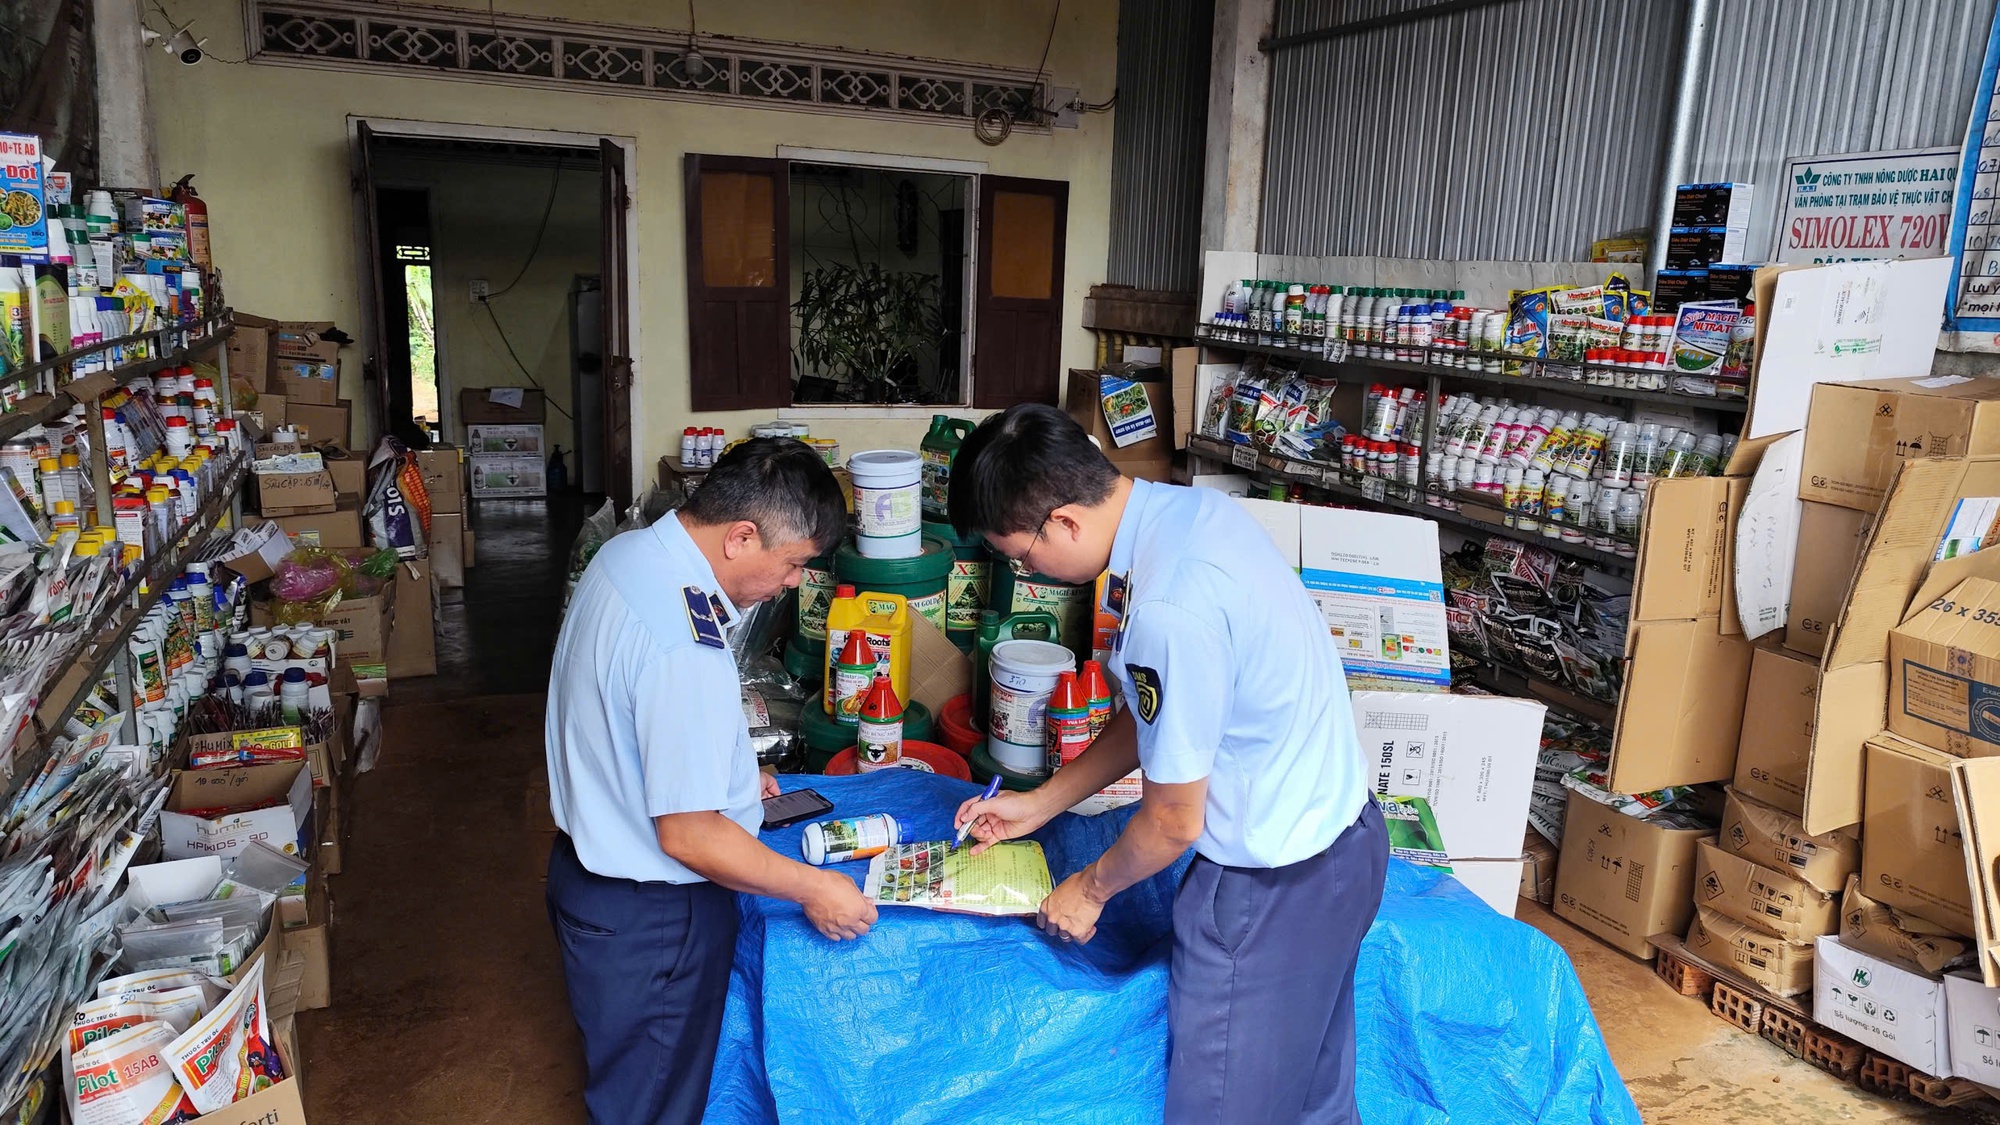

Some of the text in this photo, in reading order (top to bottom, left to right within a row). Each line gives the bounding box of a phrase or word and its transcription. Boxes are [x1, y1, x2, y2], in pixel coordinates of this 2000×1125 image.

[25, 143, 36, 156] AB
[1979, 158, 1998, 172] 07
[6, 164, 37, 182] Đọt
[1823, 172, 1841, 186] CÔNG
[1844, 173, 1852, 186] TY
[1854, 172, 1873, 184] TNHH
[1875, 168, 1896, 183] NÔNG
[1899, 168, 1918, 185] DƯỢC
[1920, 168, 1945, 182] HAI
[1795, 195, 1808, 208] VĂN
[1809, 193, 1833, 207] PHÒNG
[1835, 195, 1848, 209] TẠI
[1849, 194, 1869, 208] TRẠM
[1871, 189, 1886, 206] BẢO
[1888, 189, 1899, 207] VỆ
[1901, 191, 1922, 207] THỰC
[1924, 190, 1938, 208] VẬT
[1970, 210, 1989, 225] 09
[1789, 214, 1894, 250] SIMOLEX
[1969, 235, 1982, 249] 10
[1966, 282, 1989, 294] Lưu
[1705, 312, 1737, 323] MAGIE
[1693, 321, 1731, 334] NITRAT
[956, 563, 968, 576] X
[808, 571, 819, 584] X
[1024, 586, 1038, 599] X
[1957, 606, 1970, 617] x
[867, 637, 891, 647] Roots
[269, 740, 293, 750] GOLD
[1377, 739, 1394, 796] NATE 150SL
[196, 817, 253, 836] humic
[1834, 1009, 1896, 1041] Số lượng: 20 Gói
[1982, 1055, 1994, 1065] Số
[77, 1054, 160, 1095] Pilot 15AB
